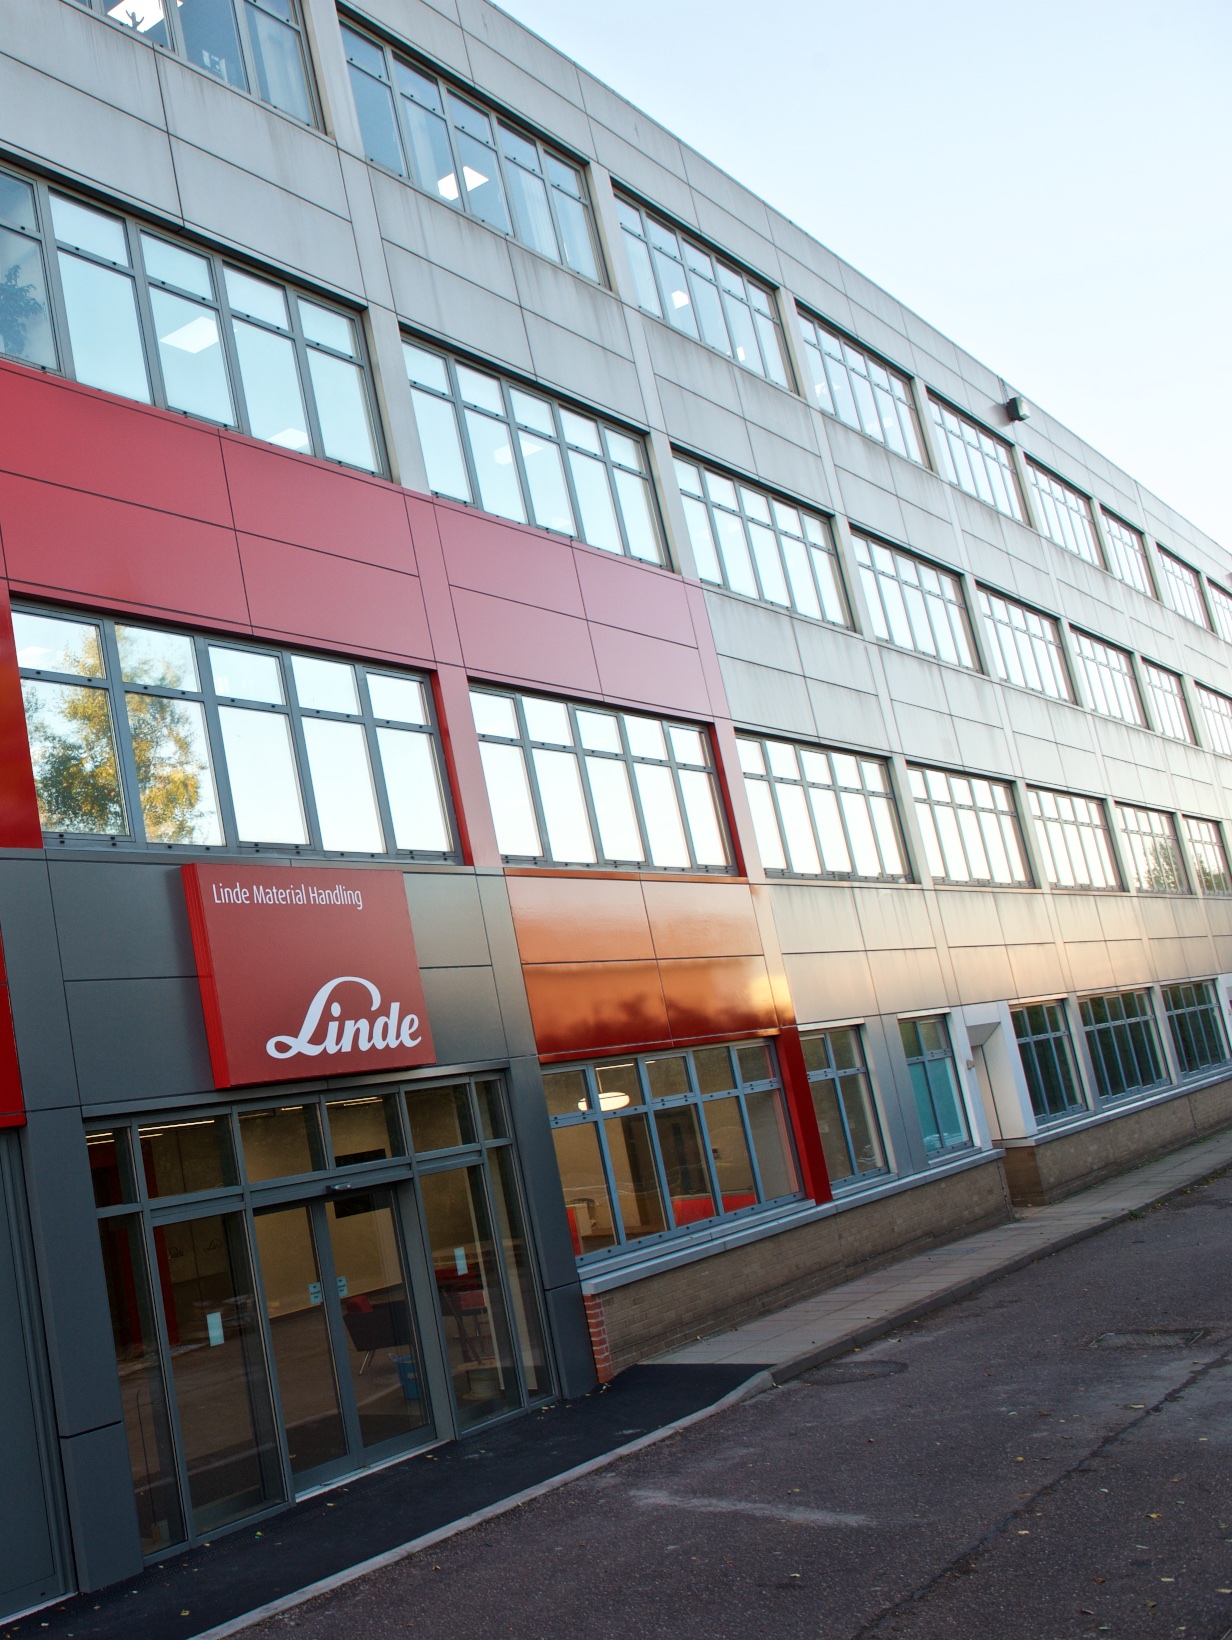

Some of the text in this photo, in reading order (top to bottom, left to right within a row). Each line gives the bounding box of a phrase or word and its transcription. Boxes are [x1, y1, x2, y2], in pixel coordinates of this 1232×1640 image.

[212, 882, 363, 910] Linde Material Handling
[266, 976, 422, 1059] Linde
